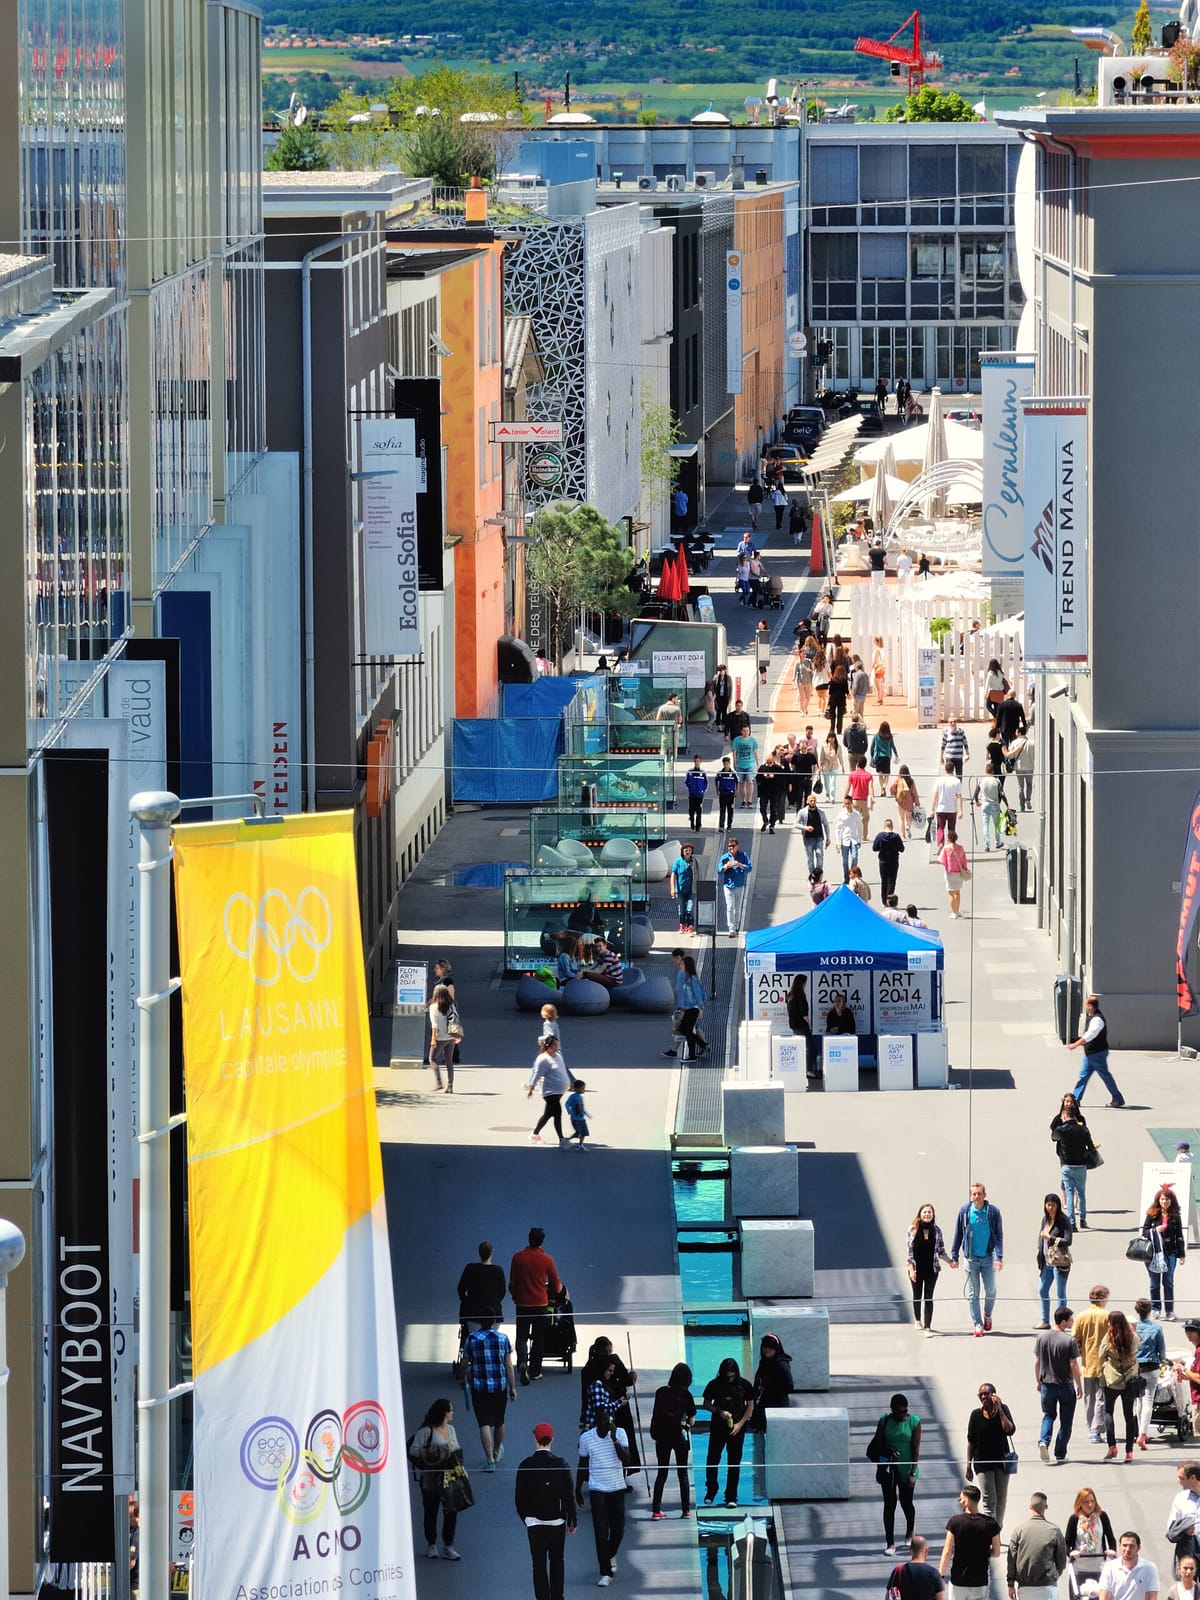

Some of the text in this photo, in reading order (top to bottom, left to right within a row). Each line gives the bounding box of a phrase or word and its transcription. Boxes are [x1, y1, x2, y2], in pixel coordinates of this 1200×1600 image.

[497, 426, 560, 435] Atelier Volant
[372, 436, 402, 450] sofia
[1059, 439, 1075, 635] TREND MANIA
[396, 510, 418, 631] Ecole Sofia
[530, 613, 540, 636] DES
[125, 679, 152, 743] vaud
[819, 955, 875, 966] MOBIMO
[818, 973, 854, 988] ART
[879, 972, 915, 987] ART
[758, 989, 788, 1004] 201
[879, 988, 922, 1003] 2014
[910, 1003, 926, 1011] MAI
[219, 998, 344, 1041] LAUSANN
[59, 1236, 104, 1492] NAVYBOOT
[257, 1436, 286, 1451] eoc
[235, 1576, 329, 1600] Association
[349, 1563, 404, 1586] Comités
